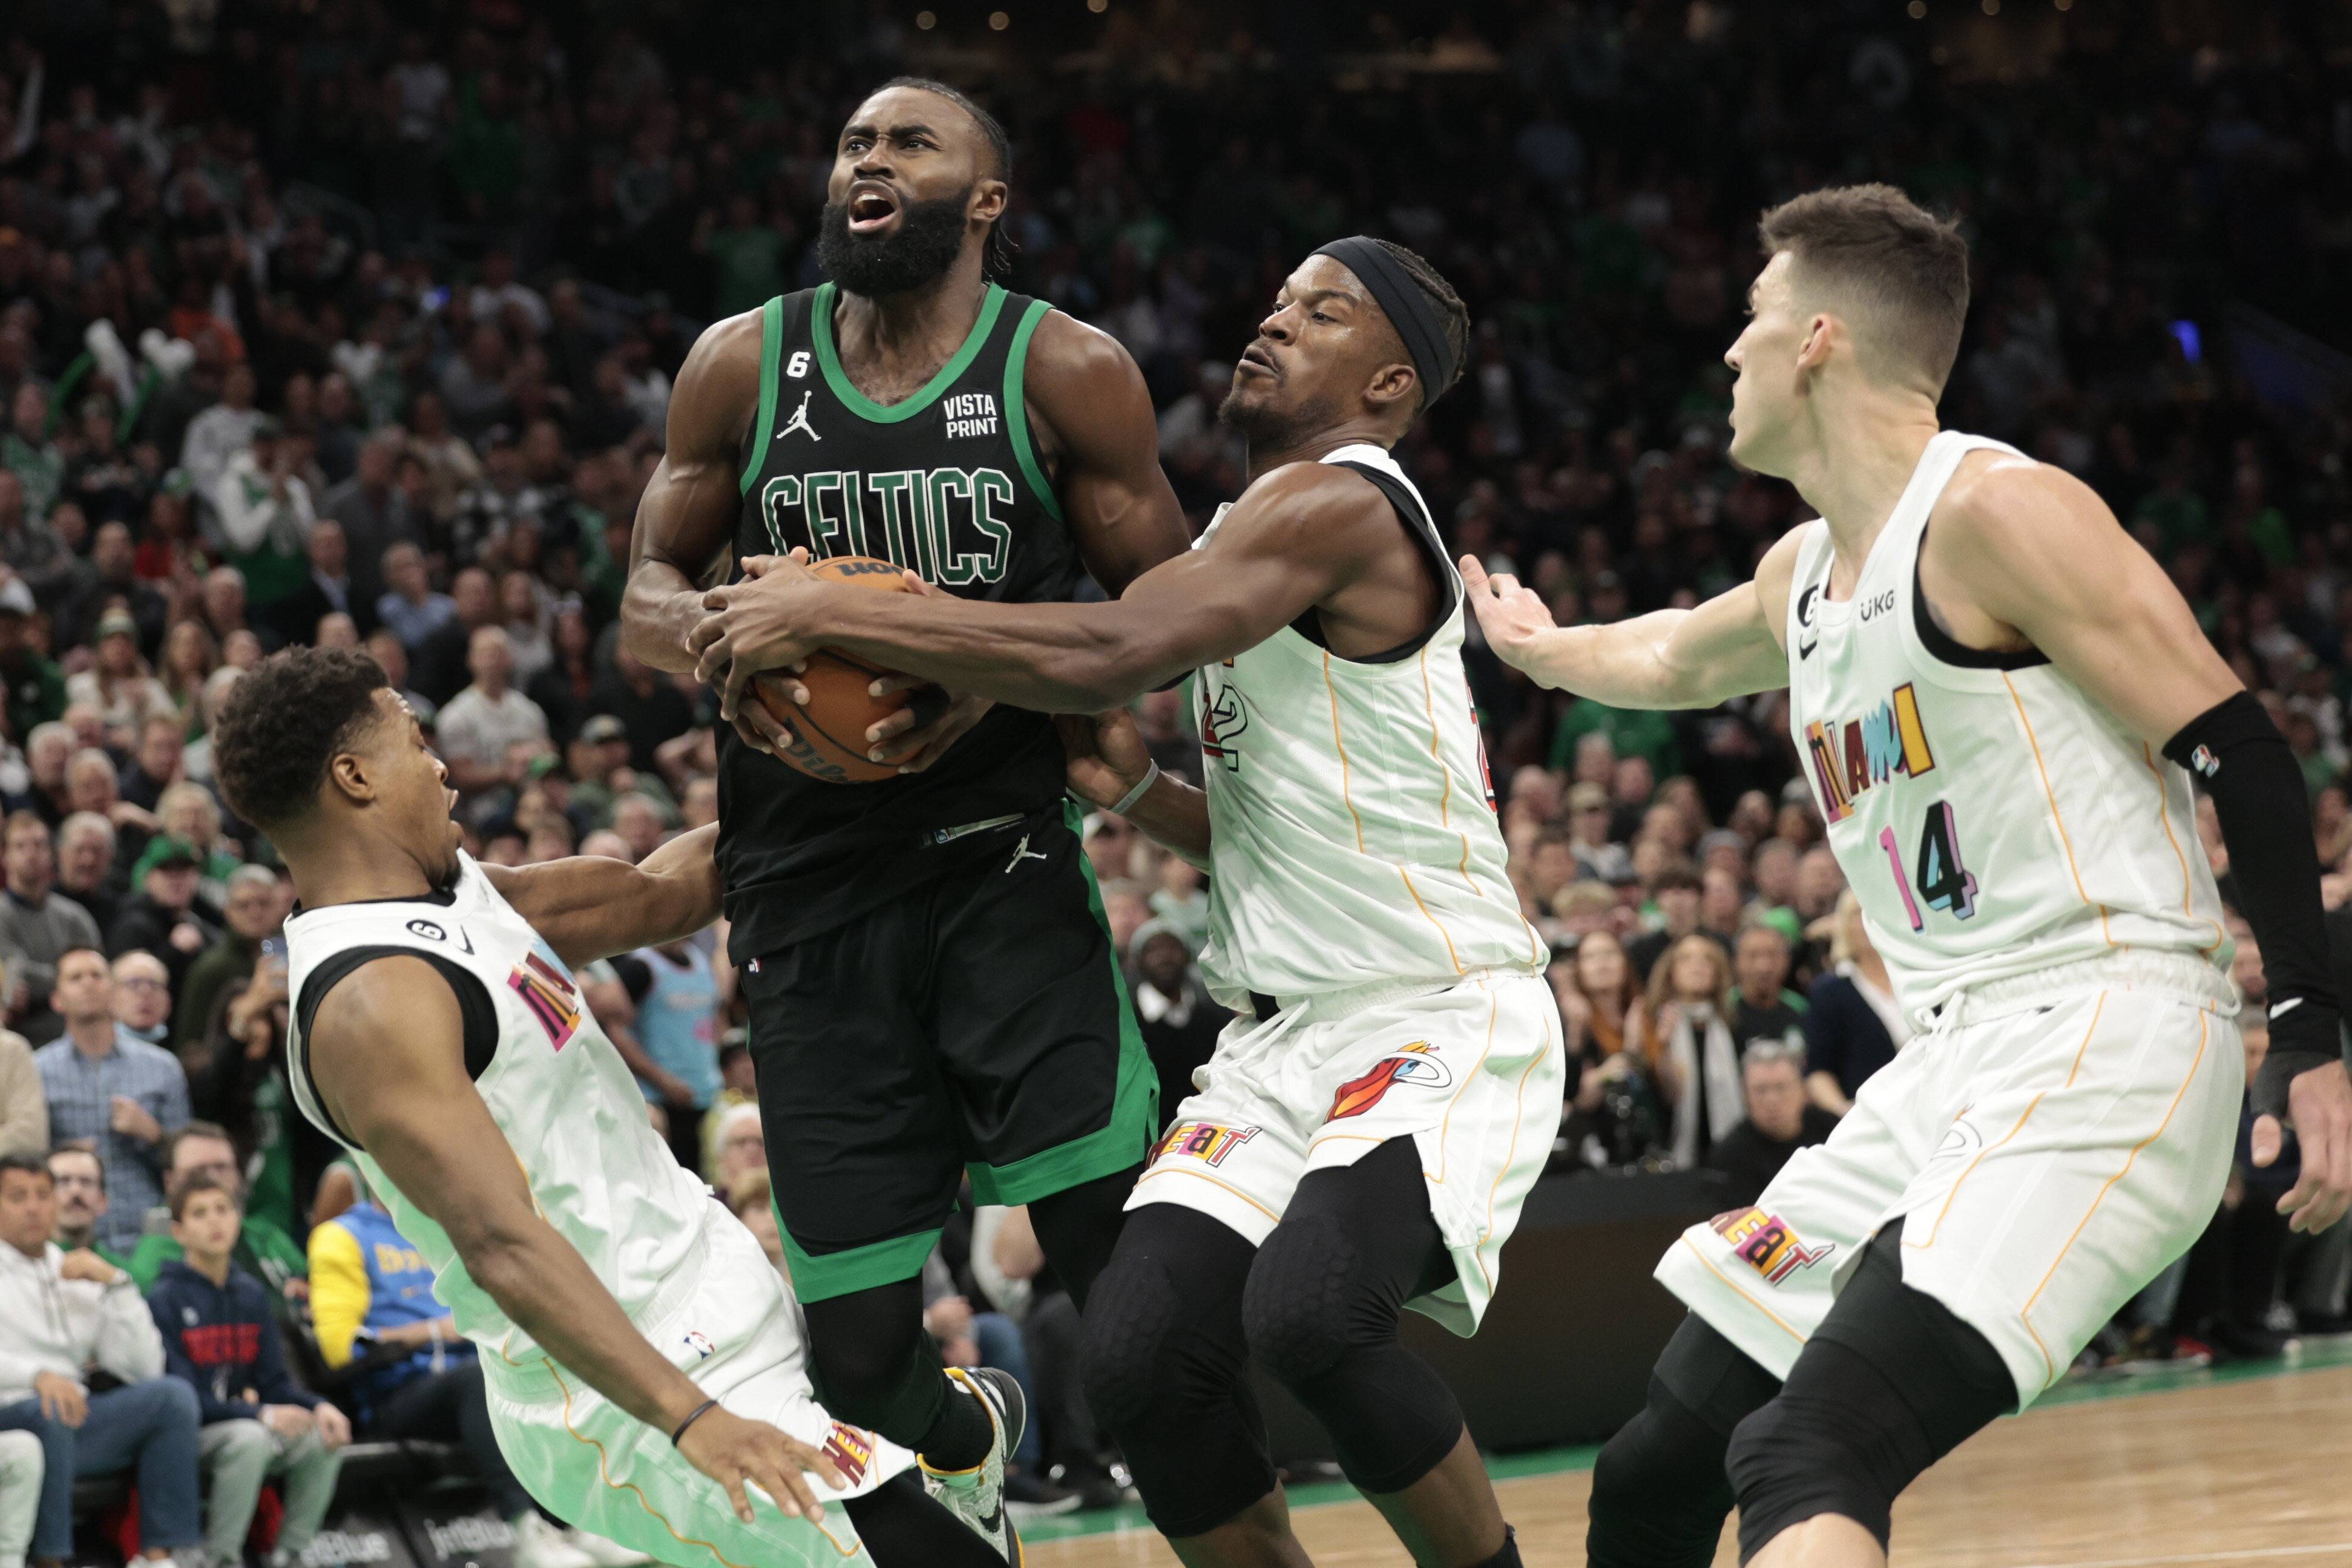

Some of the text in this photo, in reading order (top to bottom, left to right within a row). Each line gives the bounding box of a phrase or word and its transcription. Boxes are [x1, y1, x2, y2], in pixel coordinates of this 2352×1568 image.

[787, 352, 810, 378] 6
[944, 394, 996, 419] VISTA
[947, 417, 997, 439] PRINT
[1861, 589, 1894, 622] UKG
[1804, 681, 1935, 824] MIAMI
[1879, 799, 1978, 935] 14
